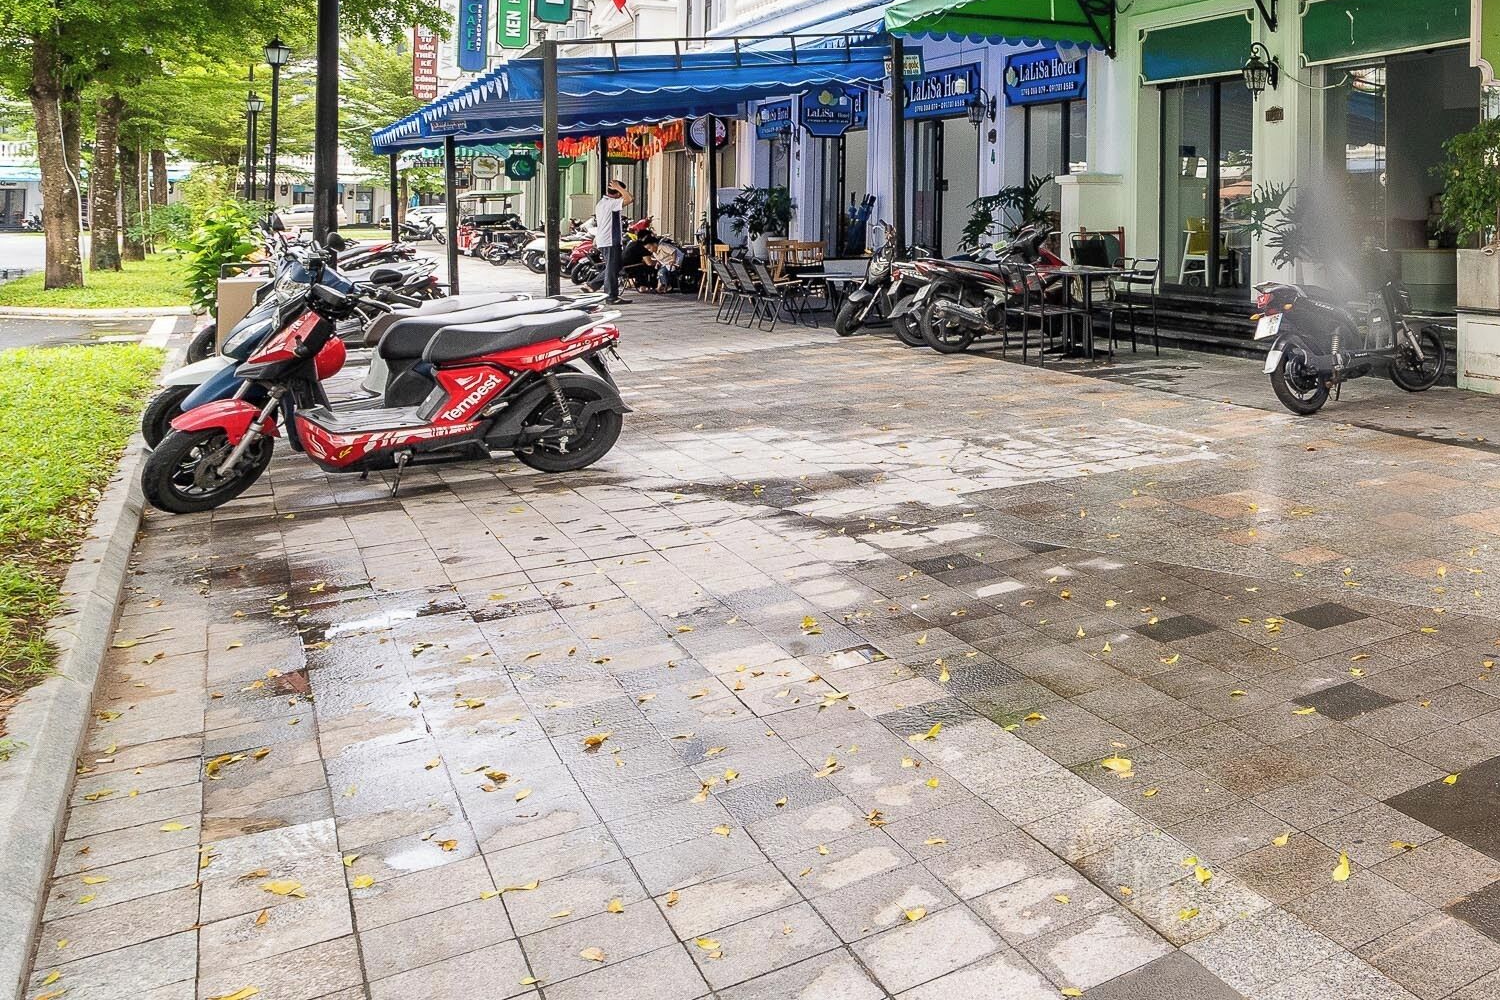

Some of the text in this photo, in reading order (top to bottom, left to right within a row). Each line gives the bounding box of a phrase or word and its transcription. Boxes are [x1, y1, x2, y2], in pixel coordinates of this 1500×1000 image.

[465, 3, 478, 52] CAFE
[505, 10, 521, 38] KEN
[1019, 60, 1050, 82] LaLiSa
[910, 76, 942, 102] LaLiSa
[807, 108, 834, 118] LaLiSa
[440, 372, 503, 422] Tempest
